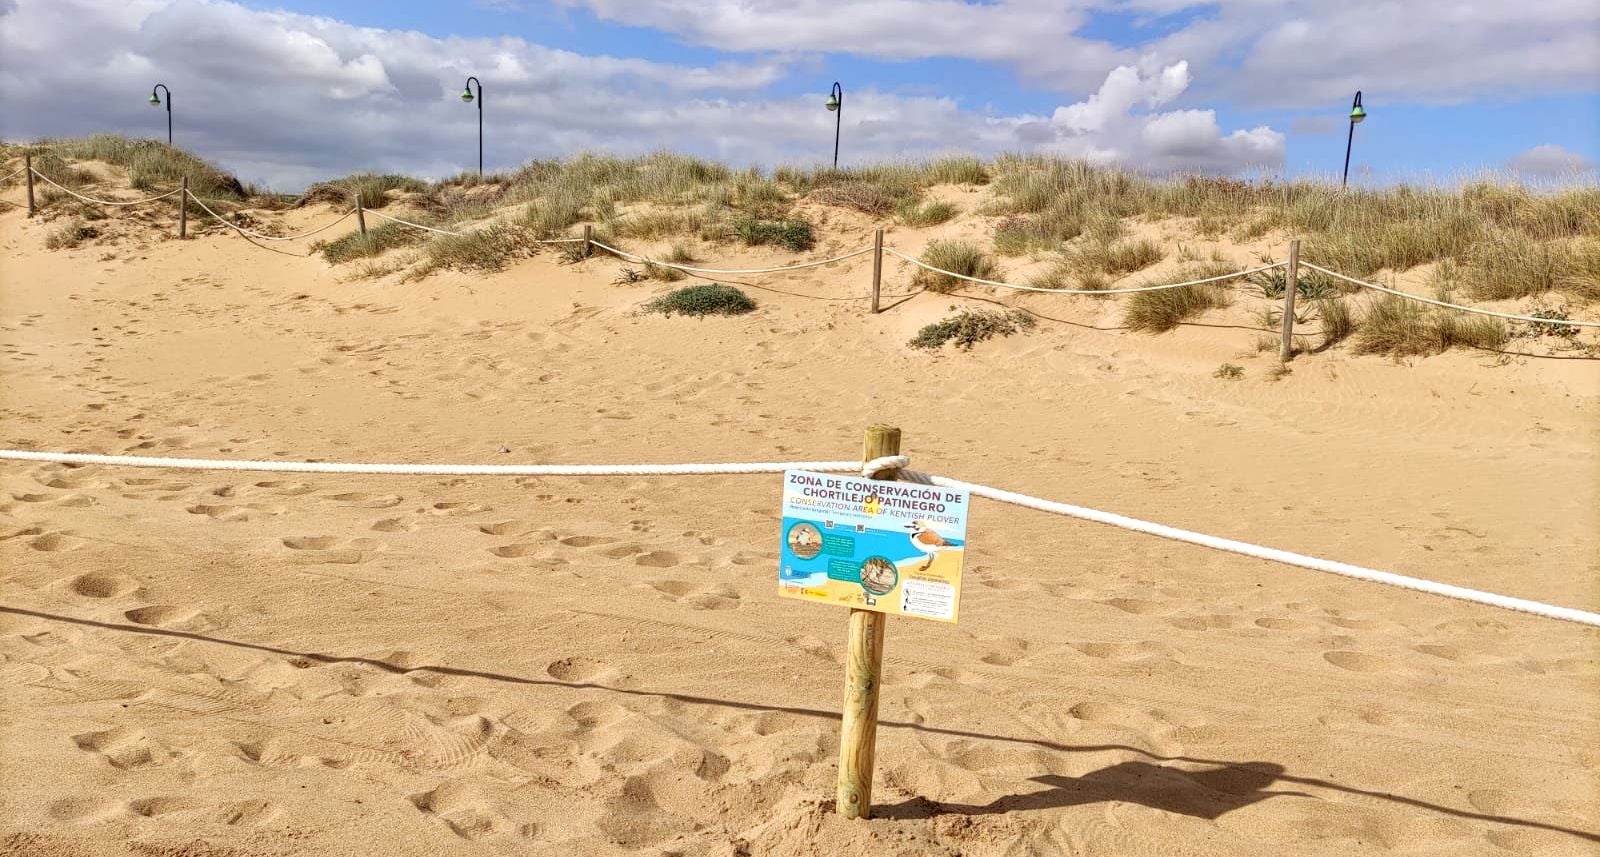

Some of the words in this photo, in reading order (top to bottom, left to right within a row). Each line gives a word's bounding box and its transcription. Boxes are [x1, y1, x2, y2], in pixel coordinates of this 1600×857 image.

[790, 474, 823, 487] ZONA
[826, 479, 842, 489] DE
[845, 481, 941, 501] CONSERVACIÓN
[945, 493, 962, 504] DE
[803, 487, 874, 504] CHORTILEJO
[877, 496, 945, 513] PATINEGRO
[790, 496, 851, 511] CONSERVATION
[852, 505, 874, 514] AREA
[889, 509, 925, 520] KENTISH
[927, 514, 960, 525] PLOVER
